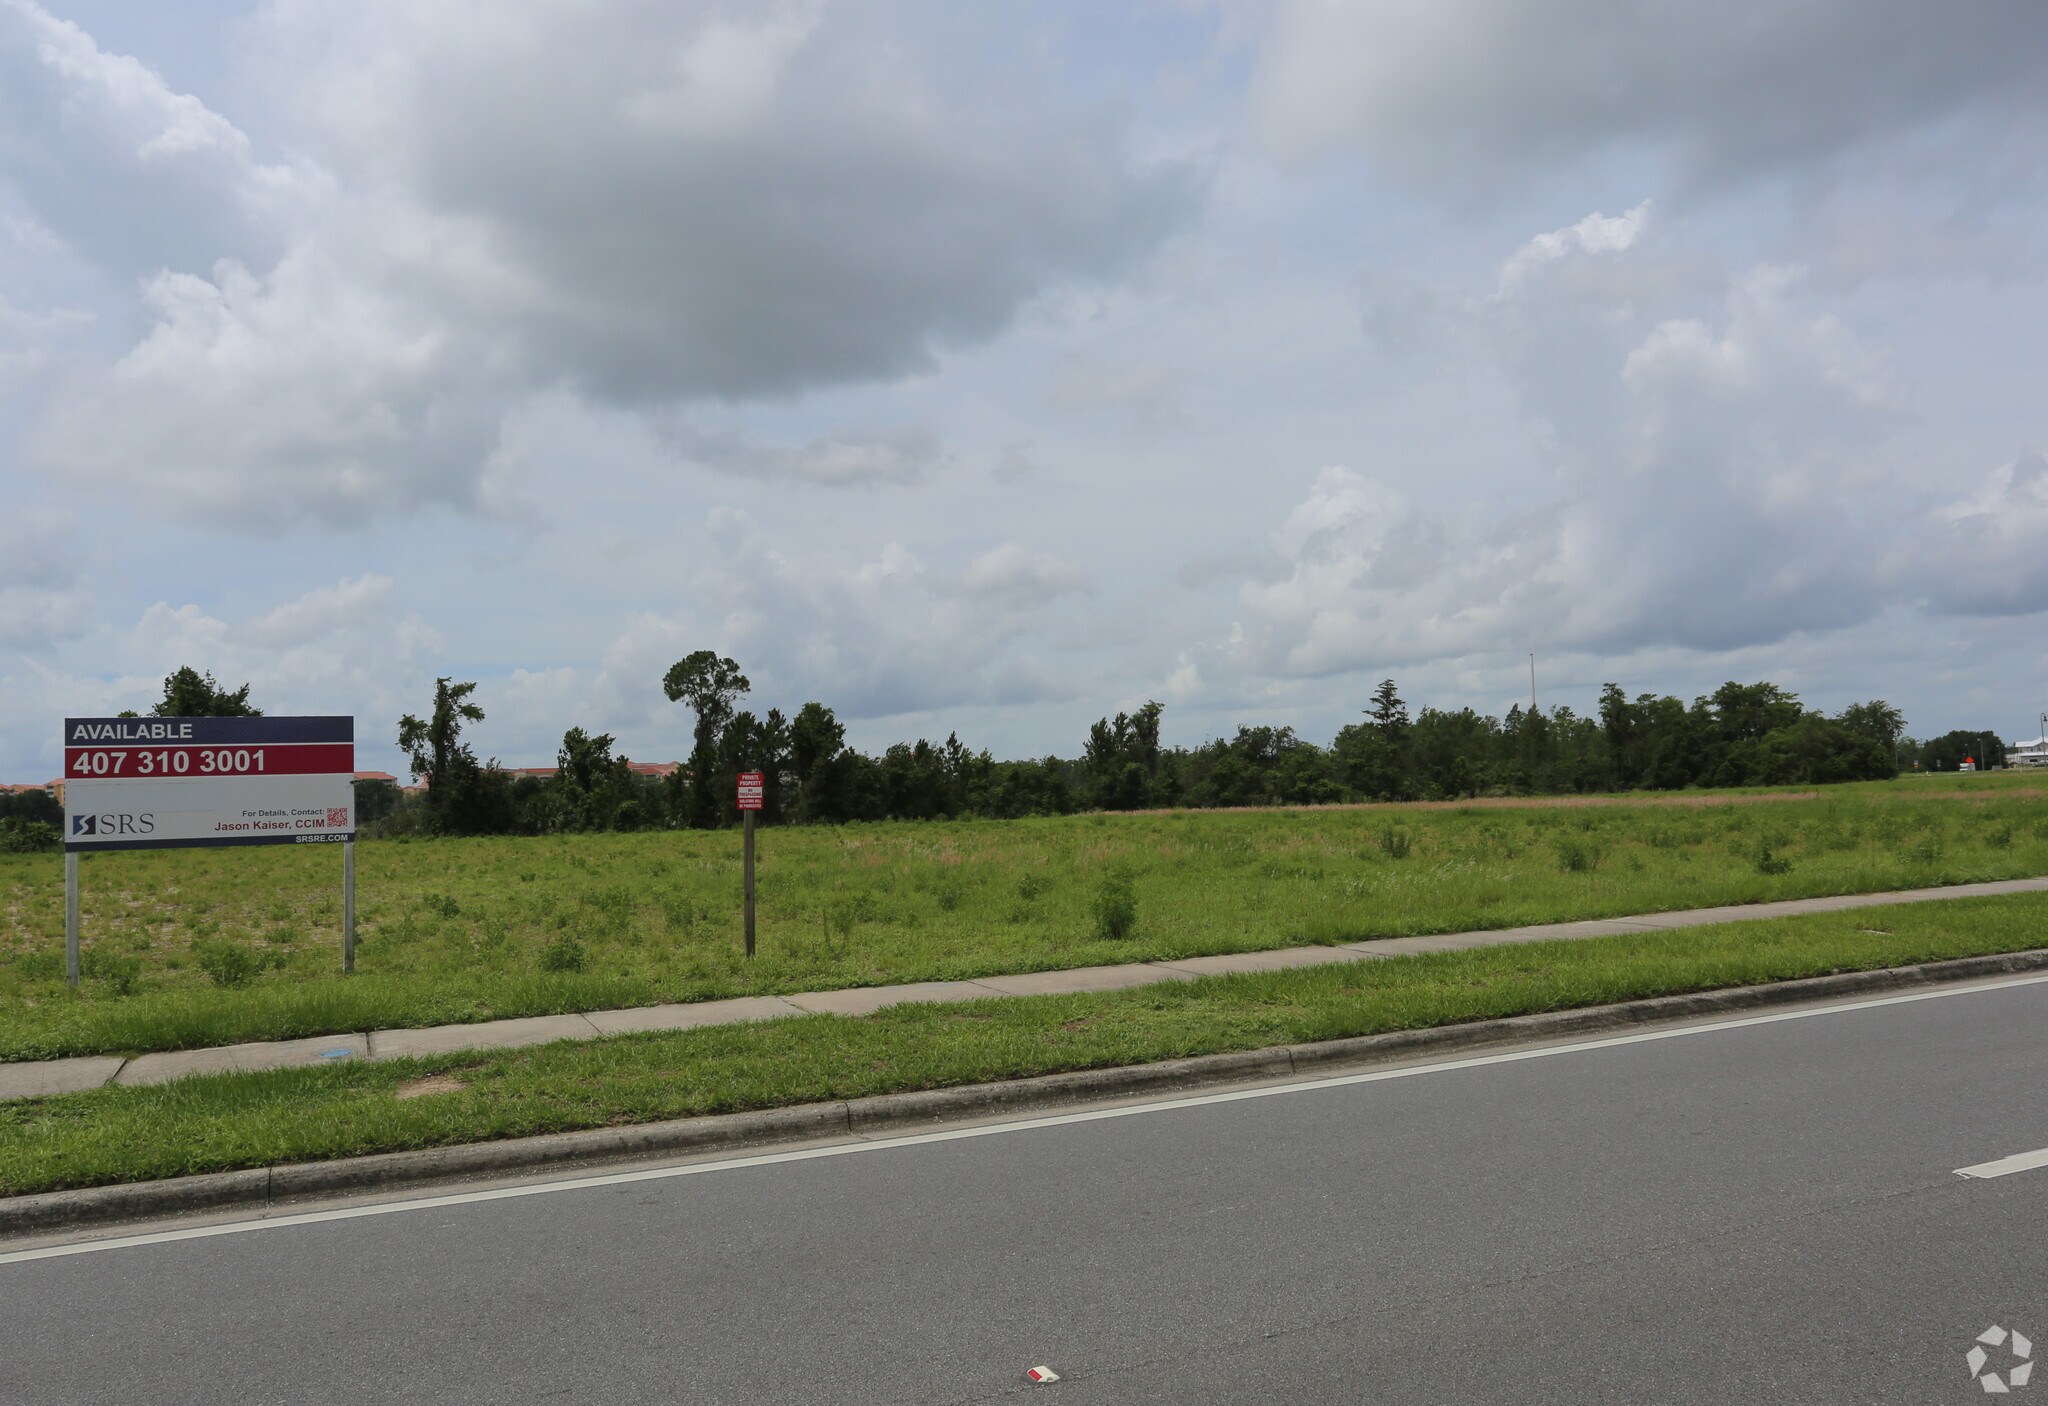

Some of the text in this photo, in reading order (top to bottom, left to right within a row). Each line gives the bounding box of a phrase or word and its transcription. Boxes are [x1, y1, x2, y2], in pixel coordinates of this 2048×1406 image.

[72, 723, 193, 740] AVAILABLE
[73, 749, 265, 774] 407 310 3001
[258, 809, 289, 817] Details,
[291, 808, 325, 816] Contact:
[100, 813, 154, 835] SRS
[214, 819, 325, 831] Jason Kaiser, CCIM
[295, 834, 348, 843] SRSRE.COM
